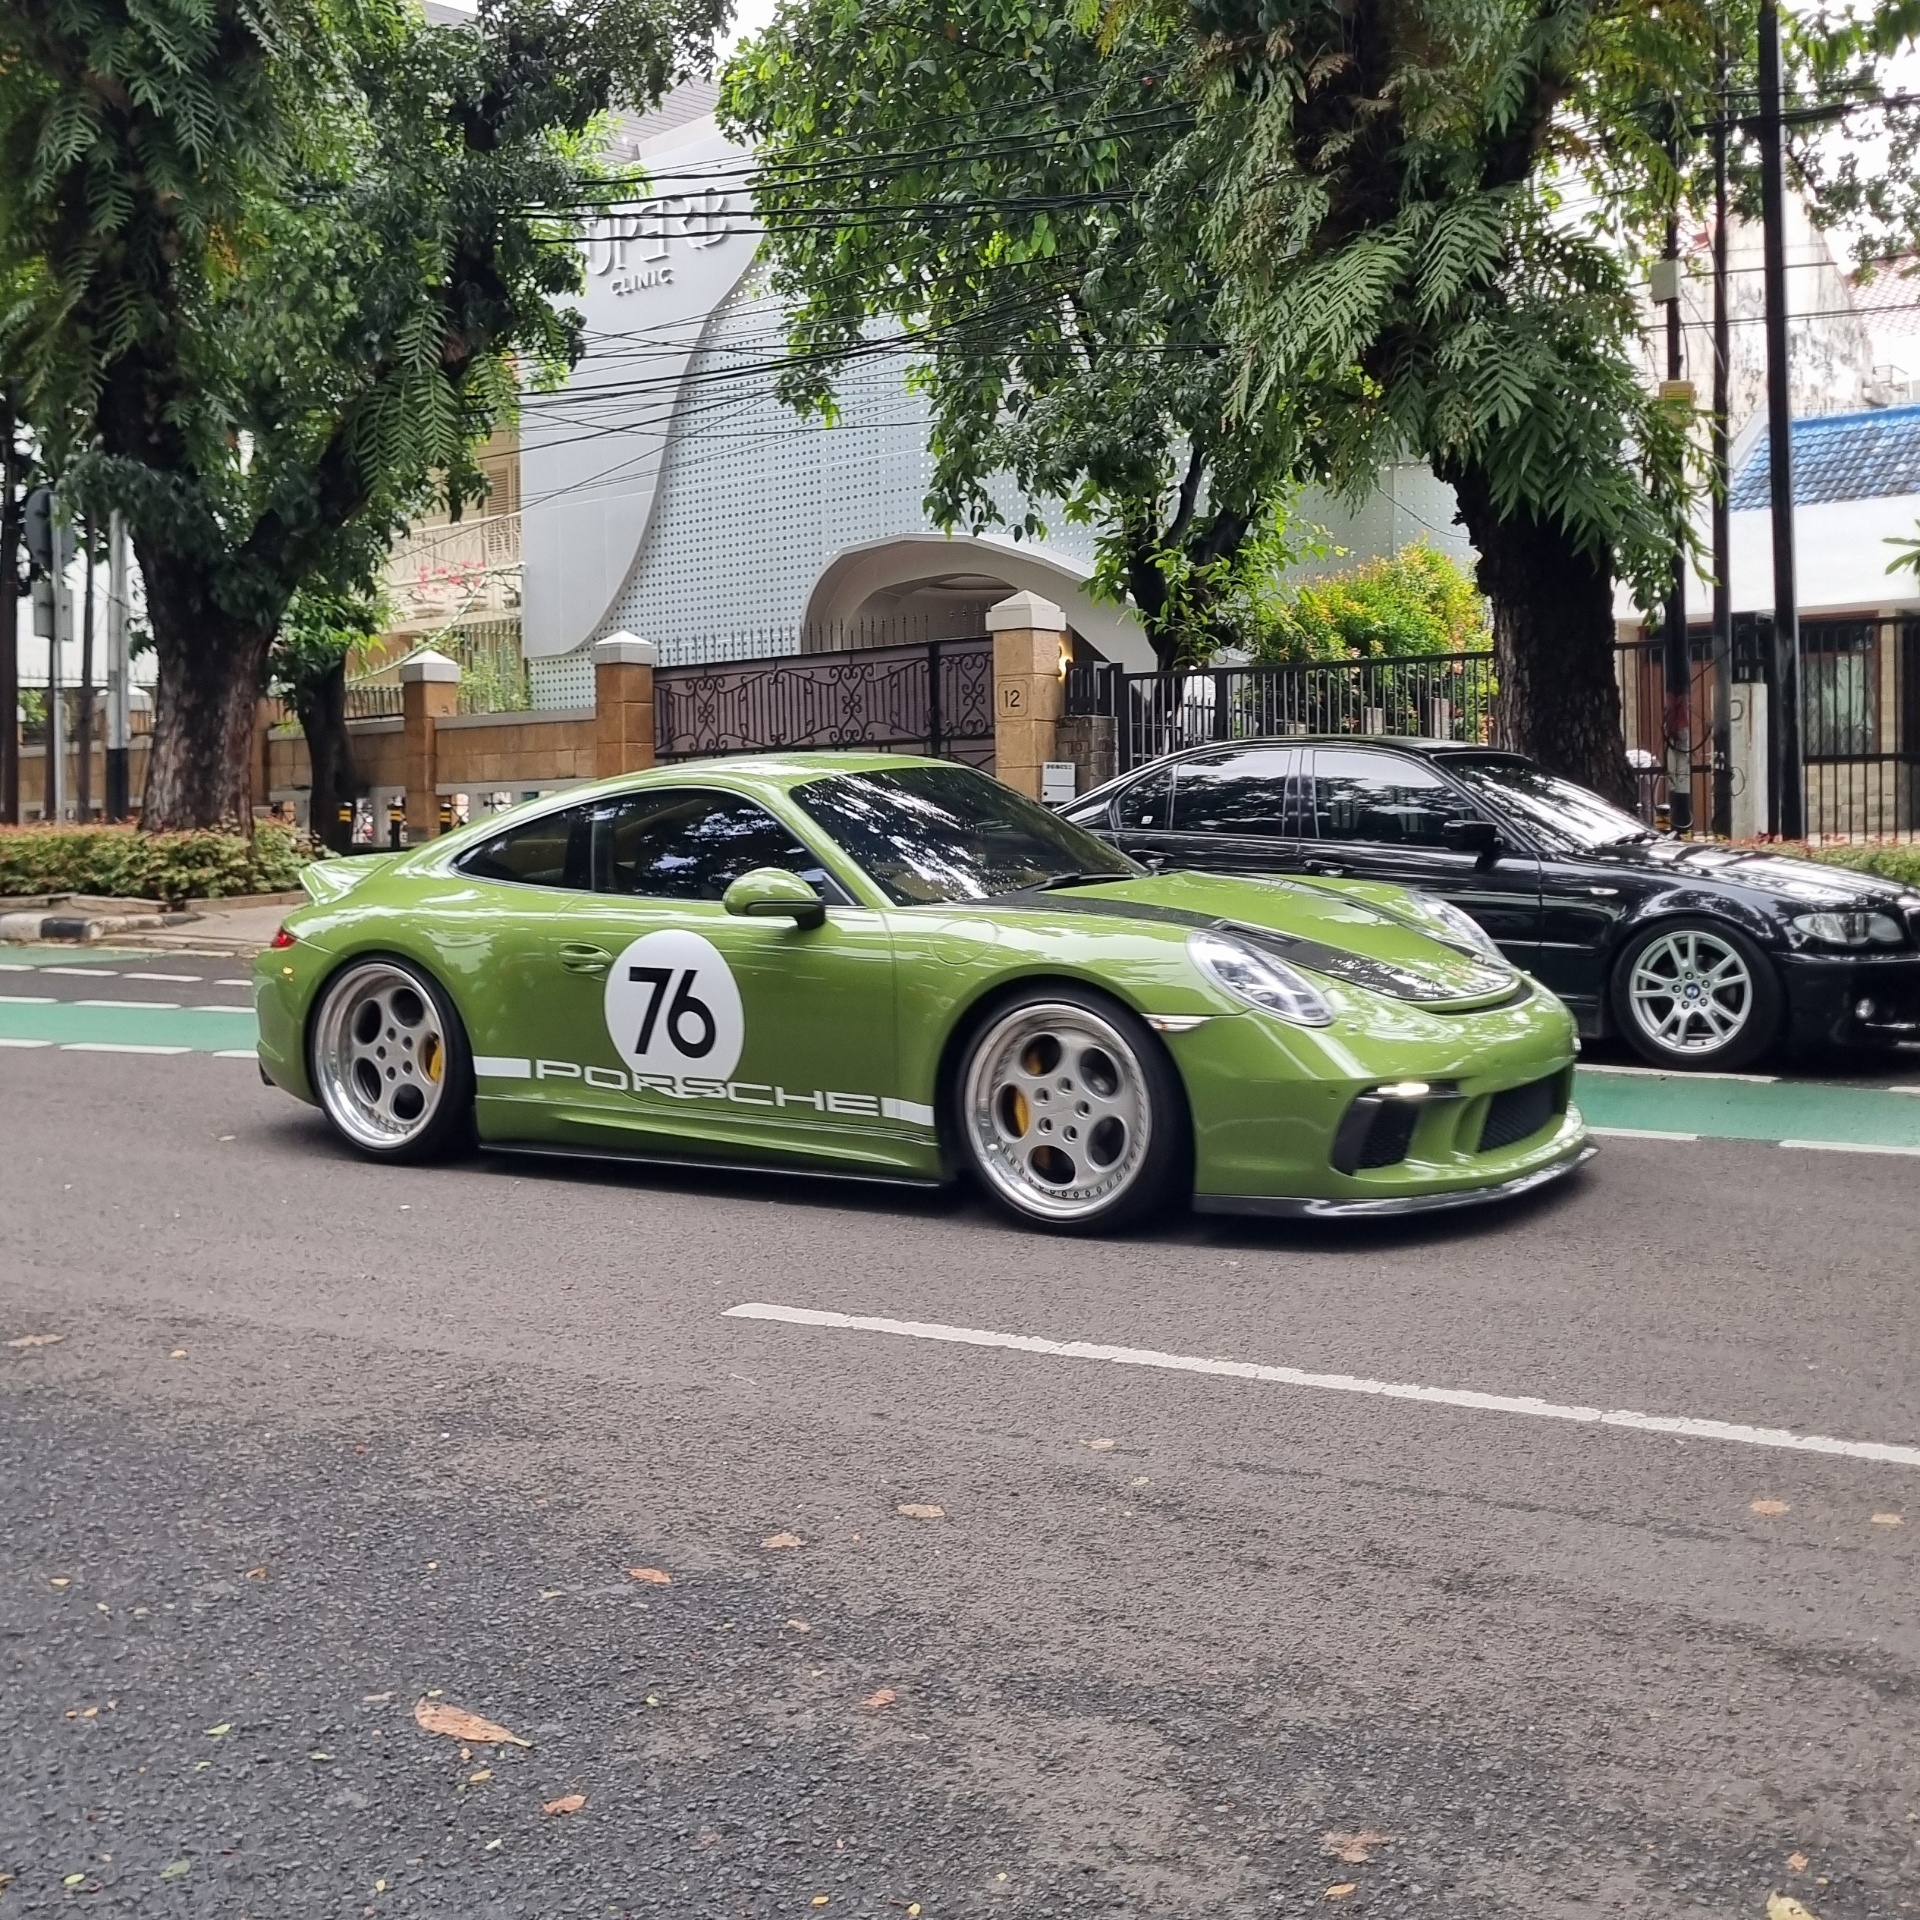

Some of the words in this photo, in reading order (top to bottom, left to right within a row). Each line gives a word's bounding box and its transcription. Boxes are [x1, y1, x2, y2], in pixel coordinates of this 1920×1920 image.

[610, 266, 674, 295] CLINIC
[1004, 689, 1021, 708] 12
[628, 966, 716, 1059] 76
[535, 1059, 880, 1117] PORSCHE
